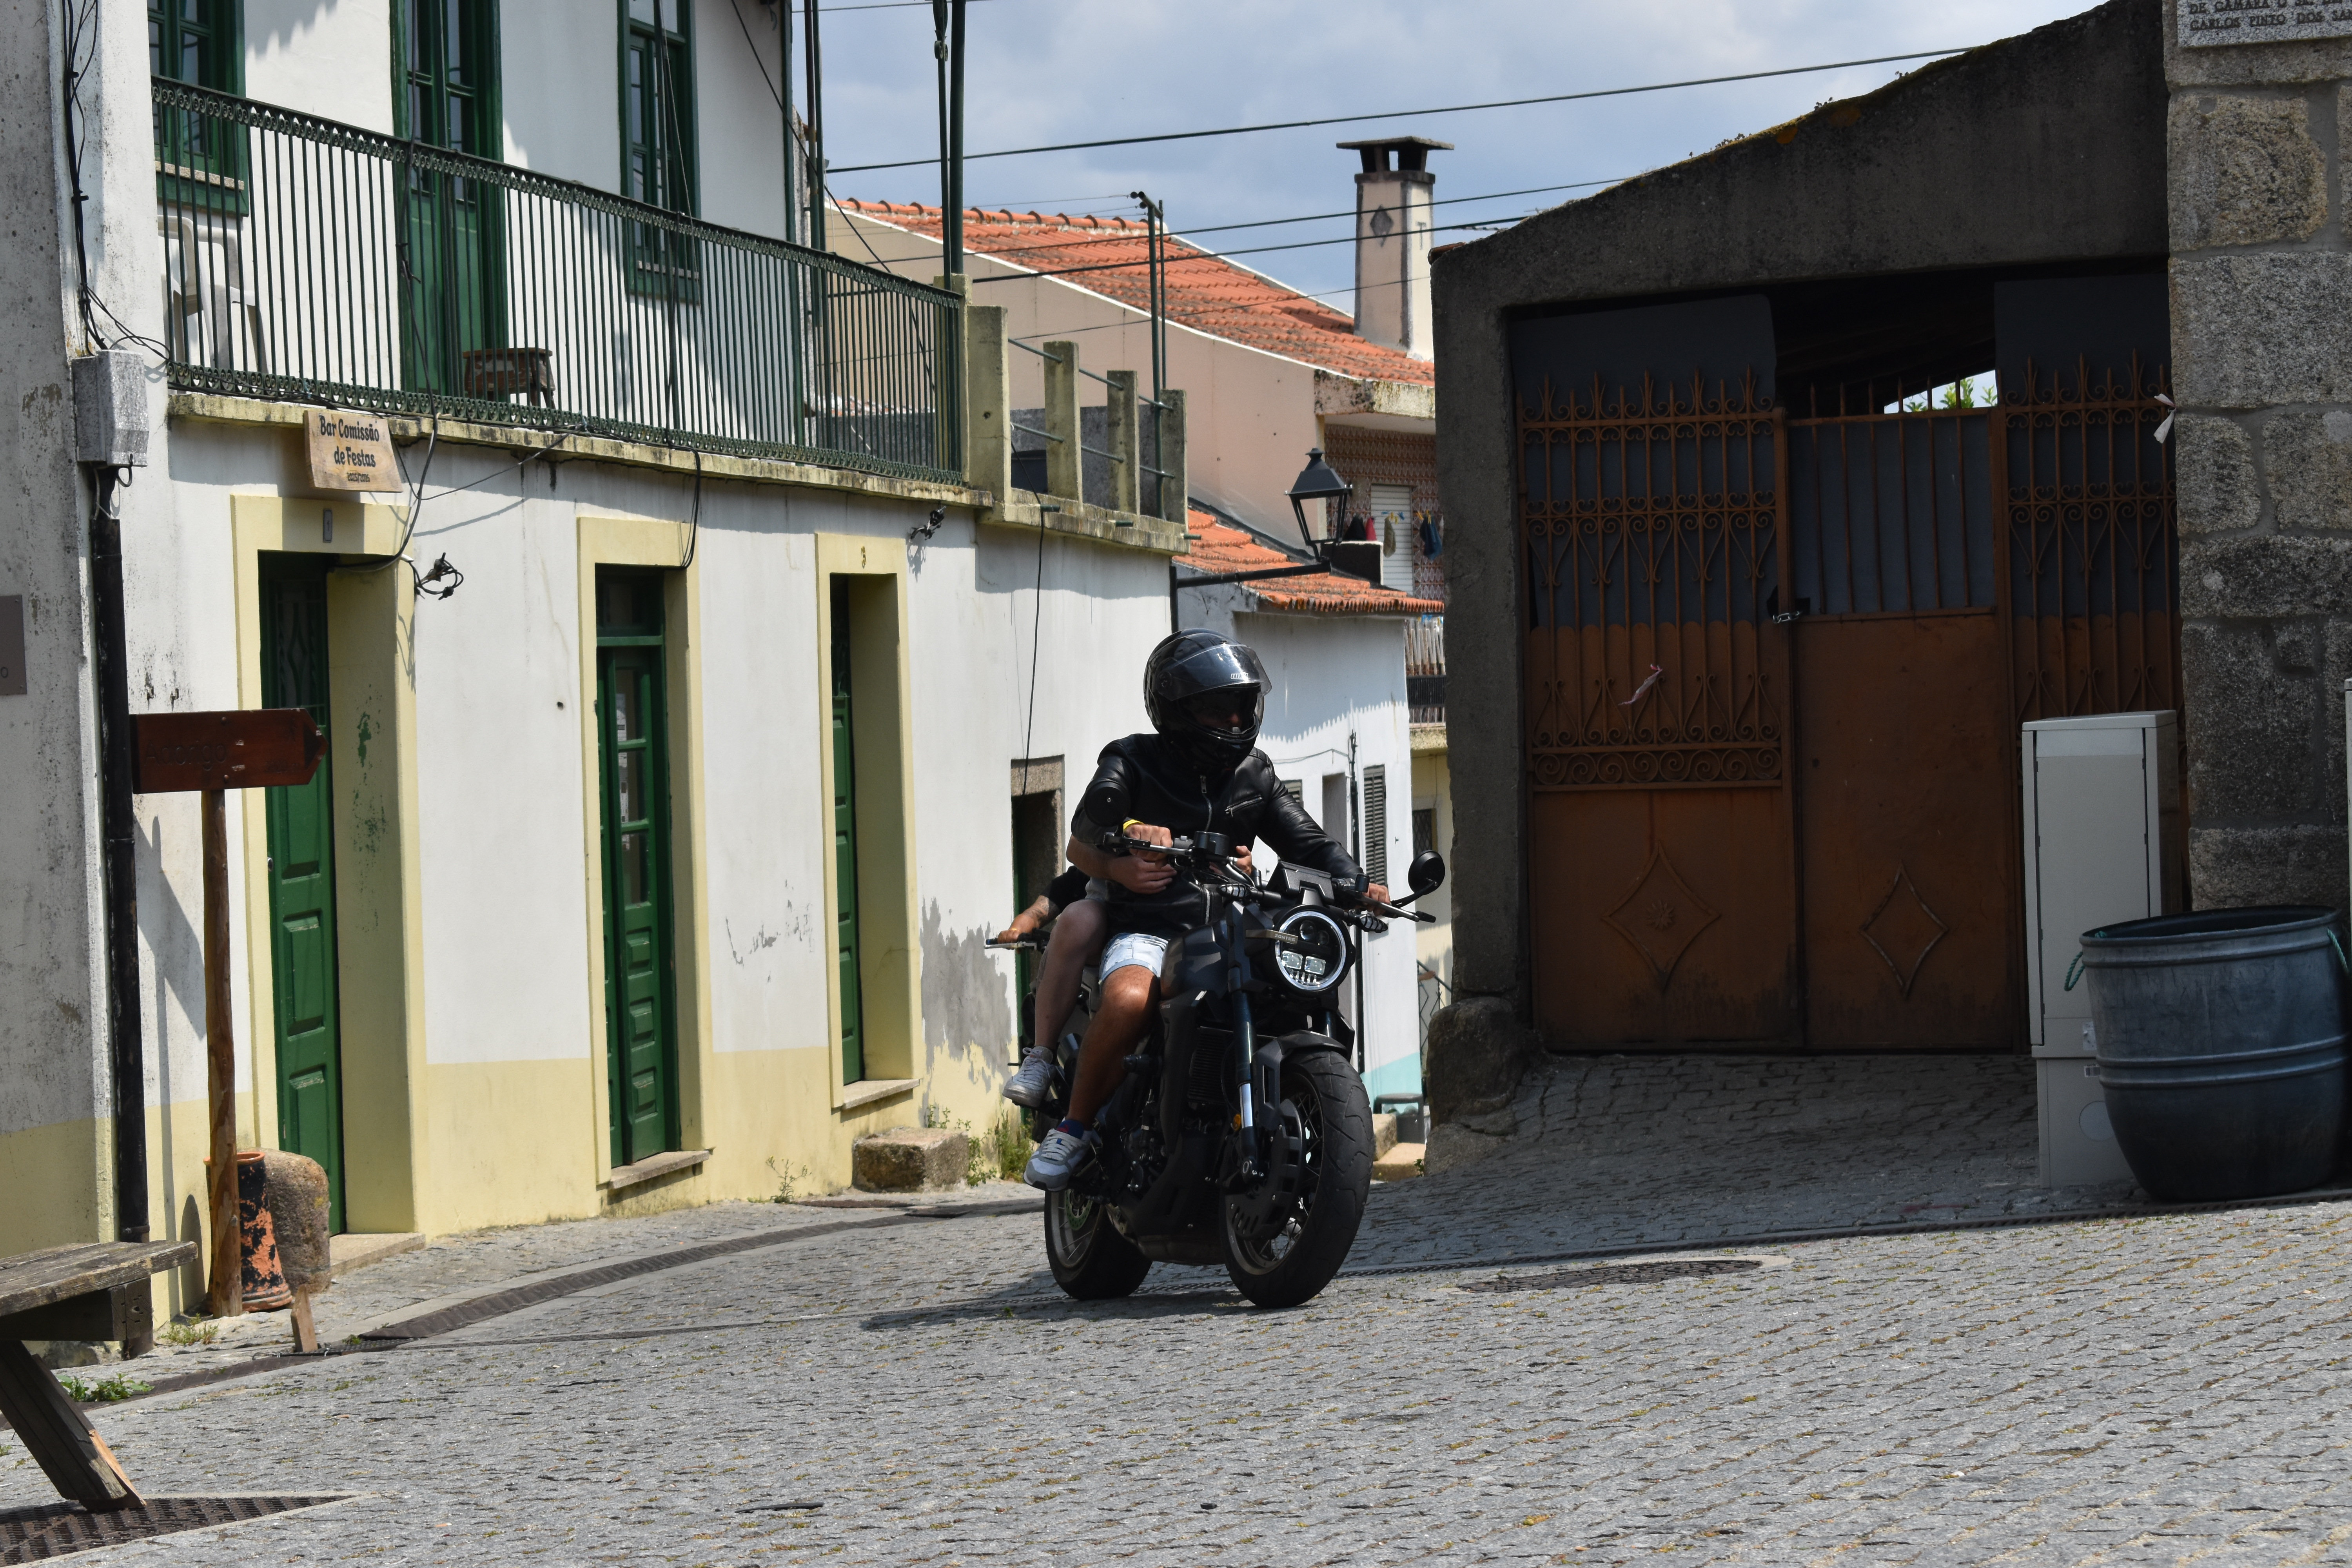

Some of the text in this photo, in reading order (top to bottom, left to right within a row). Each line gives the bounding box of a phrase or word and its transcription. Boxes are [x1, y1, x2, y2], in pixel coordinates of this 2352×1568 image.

[2190, 3, 2208, 14] DE
[2190, 17, 2241, 31] CARLOS
[2249, 14, 2286, 27] PINTO
[2297, 11, 2325, 24] DOS
[320, 415, 379, 442] Bar Comissão
[334, 445, 376, 468] de Festas
